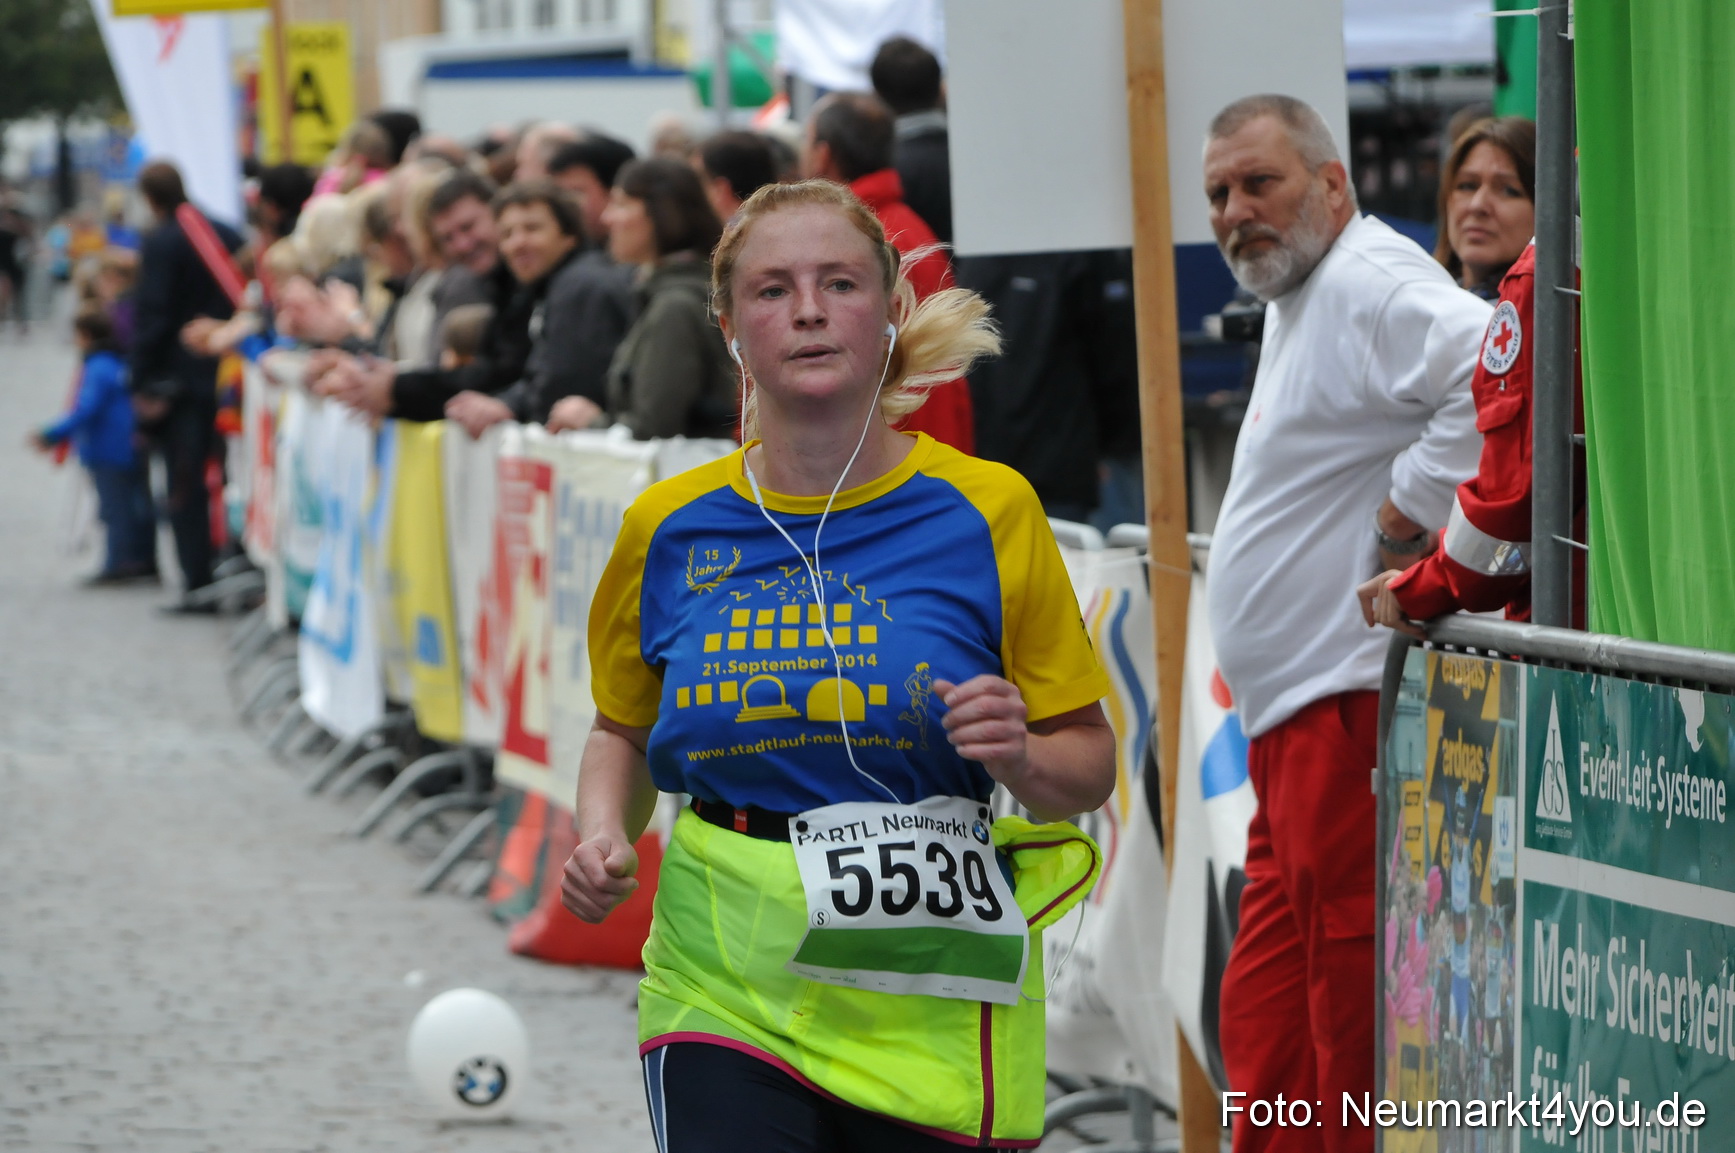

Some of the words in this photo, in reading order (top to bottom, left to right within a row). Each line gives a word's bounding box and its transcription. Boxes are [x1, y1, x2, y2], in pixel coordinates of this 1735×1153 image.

[705, 549, 719, 561] 15
[702, 655, 827, 676] 21.September
[834, 653, 877, 668] 2014
[1580, 741, 1726, 829] Event-Leit-Systeme
[797, 820, 878, 846] PARTL
[882, 813, 967, 839] Neumarkt
[825, 840, 1003, 922] 5539
[816, 911, 825, 926] S
[1533, 920, 1600, 1021] Mehr
[1606, 936, 1735, 1061] Sicherheit
